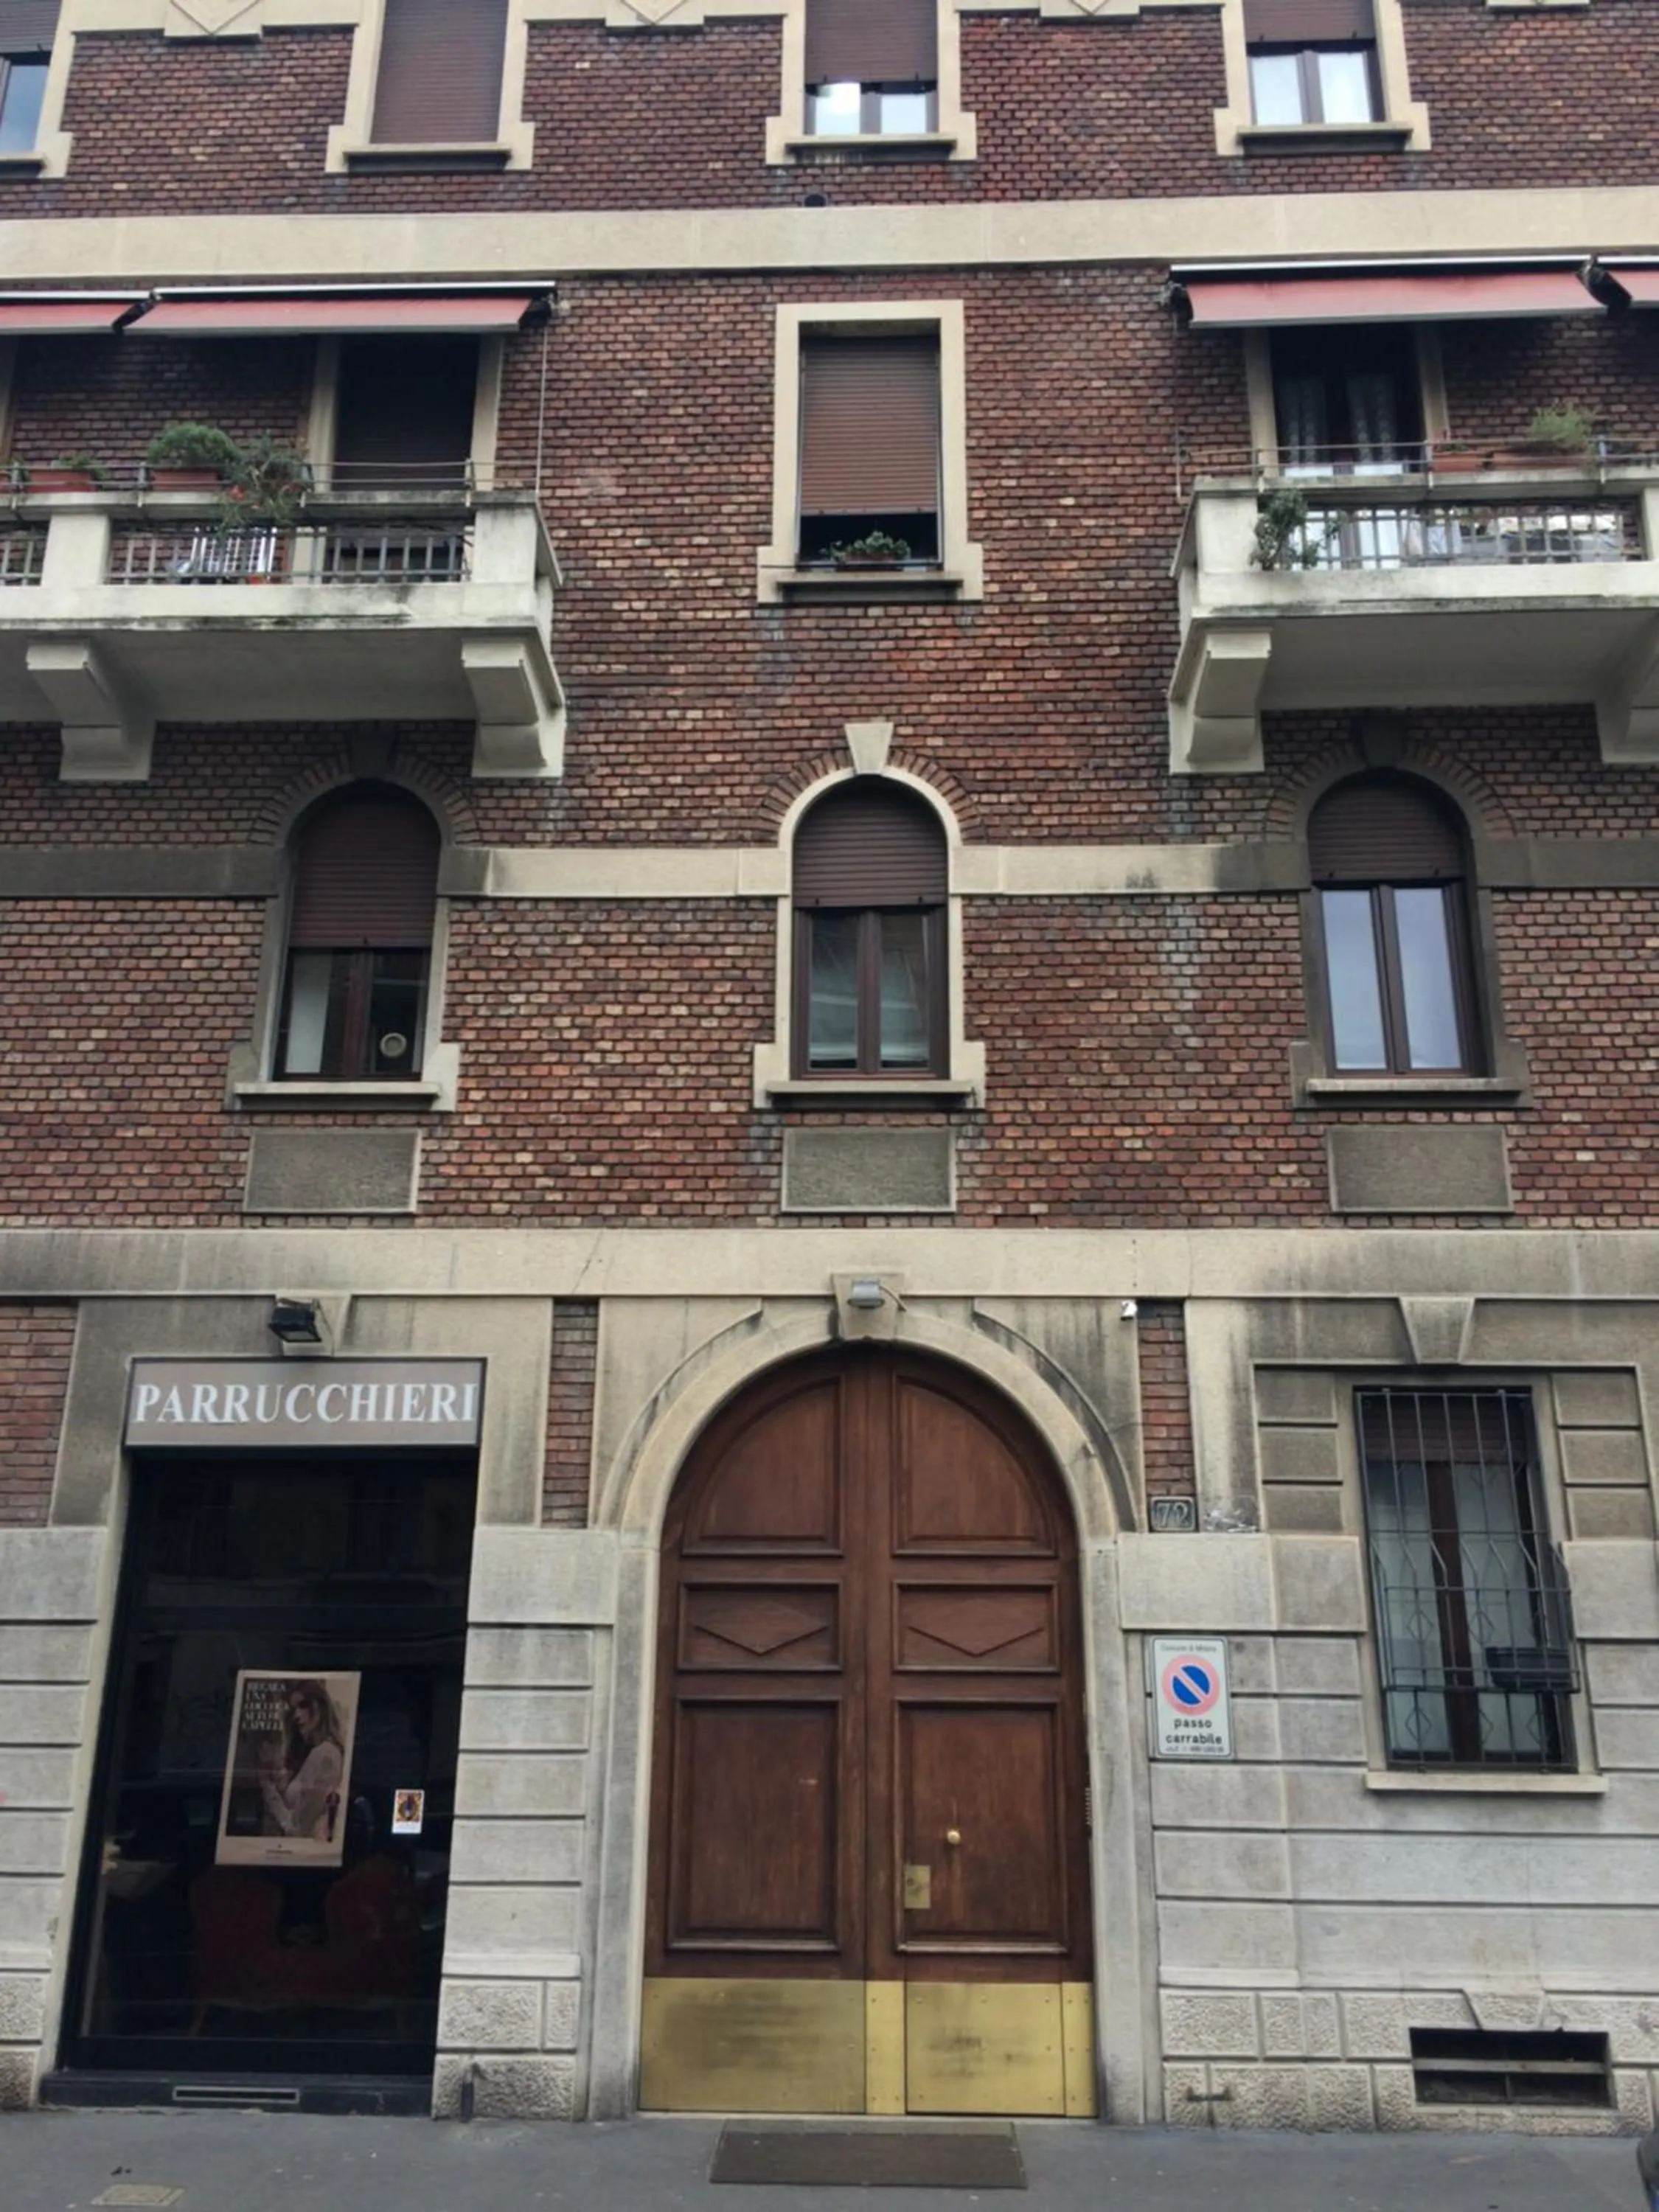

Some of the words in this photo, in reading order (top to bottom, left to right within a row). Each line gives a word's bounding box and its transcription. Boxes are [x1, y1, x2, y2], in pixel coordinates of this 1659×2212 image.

[133, 1382, 479, 1424] PARRUCCHIERI
[1174, 1719, 1212, 1728] passo
[1166, 1733, 1222, 1744] carrabile
